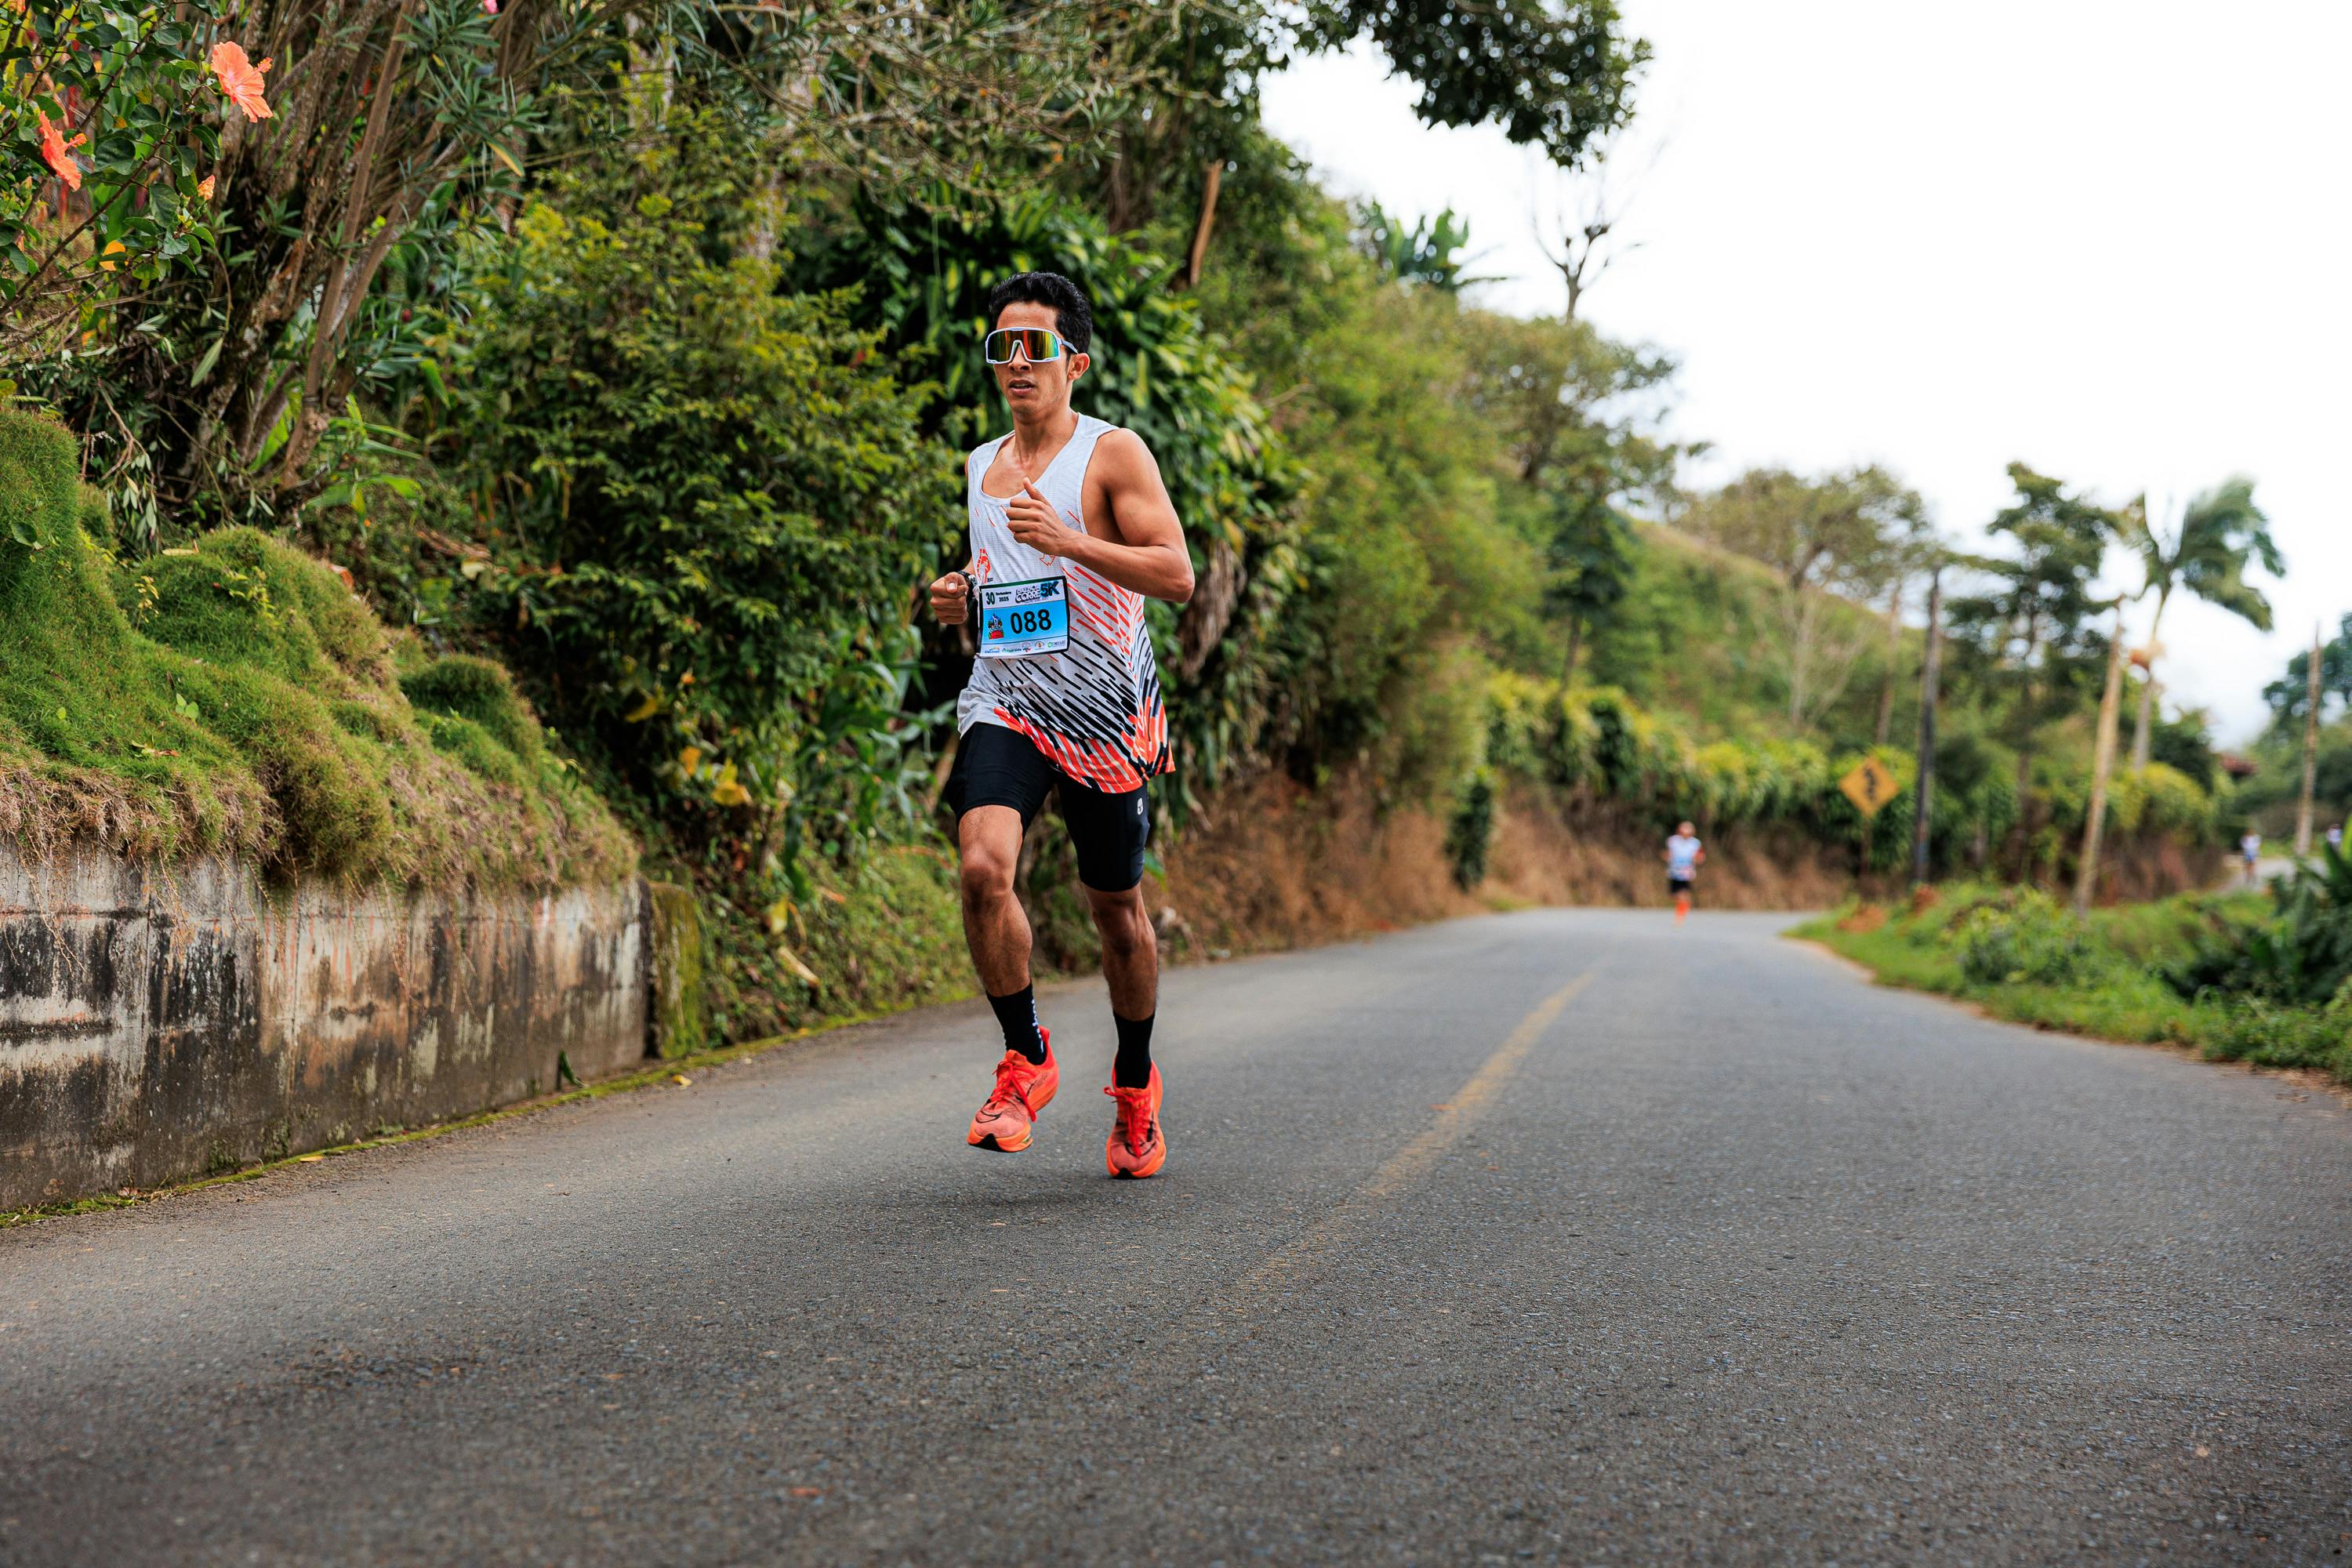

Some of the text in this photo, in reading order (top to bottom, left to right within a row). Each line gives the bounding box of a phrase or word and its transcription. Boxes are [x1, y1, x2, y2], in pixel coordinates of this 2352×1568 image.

[985, 592, 995, 604] 30
[1015, 590, 1040, 603] CORRE
[1040, 581, 1060, 597] 5K
[1011, 609, 1051, 634] 088
